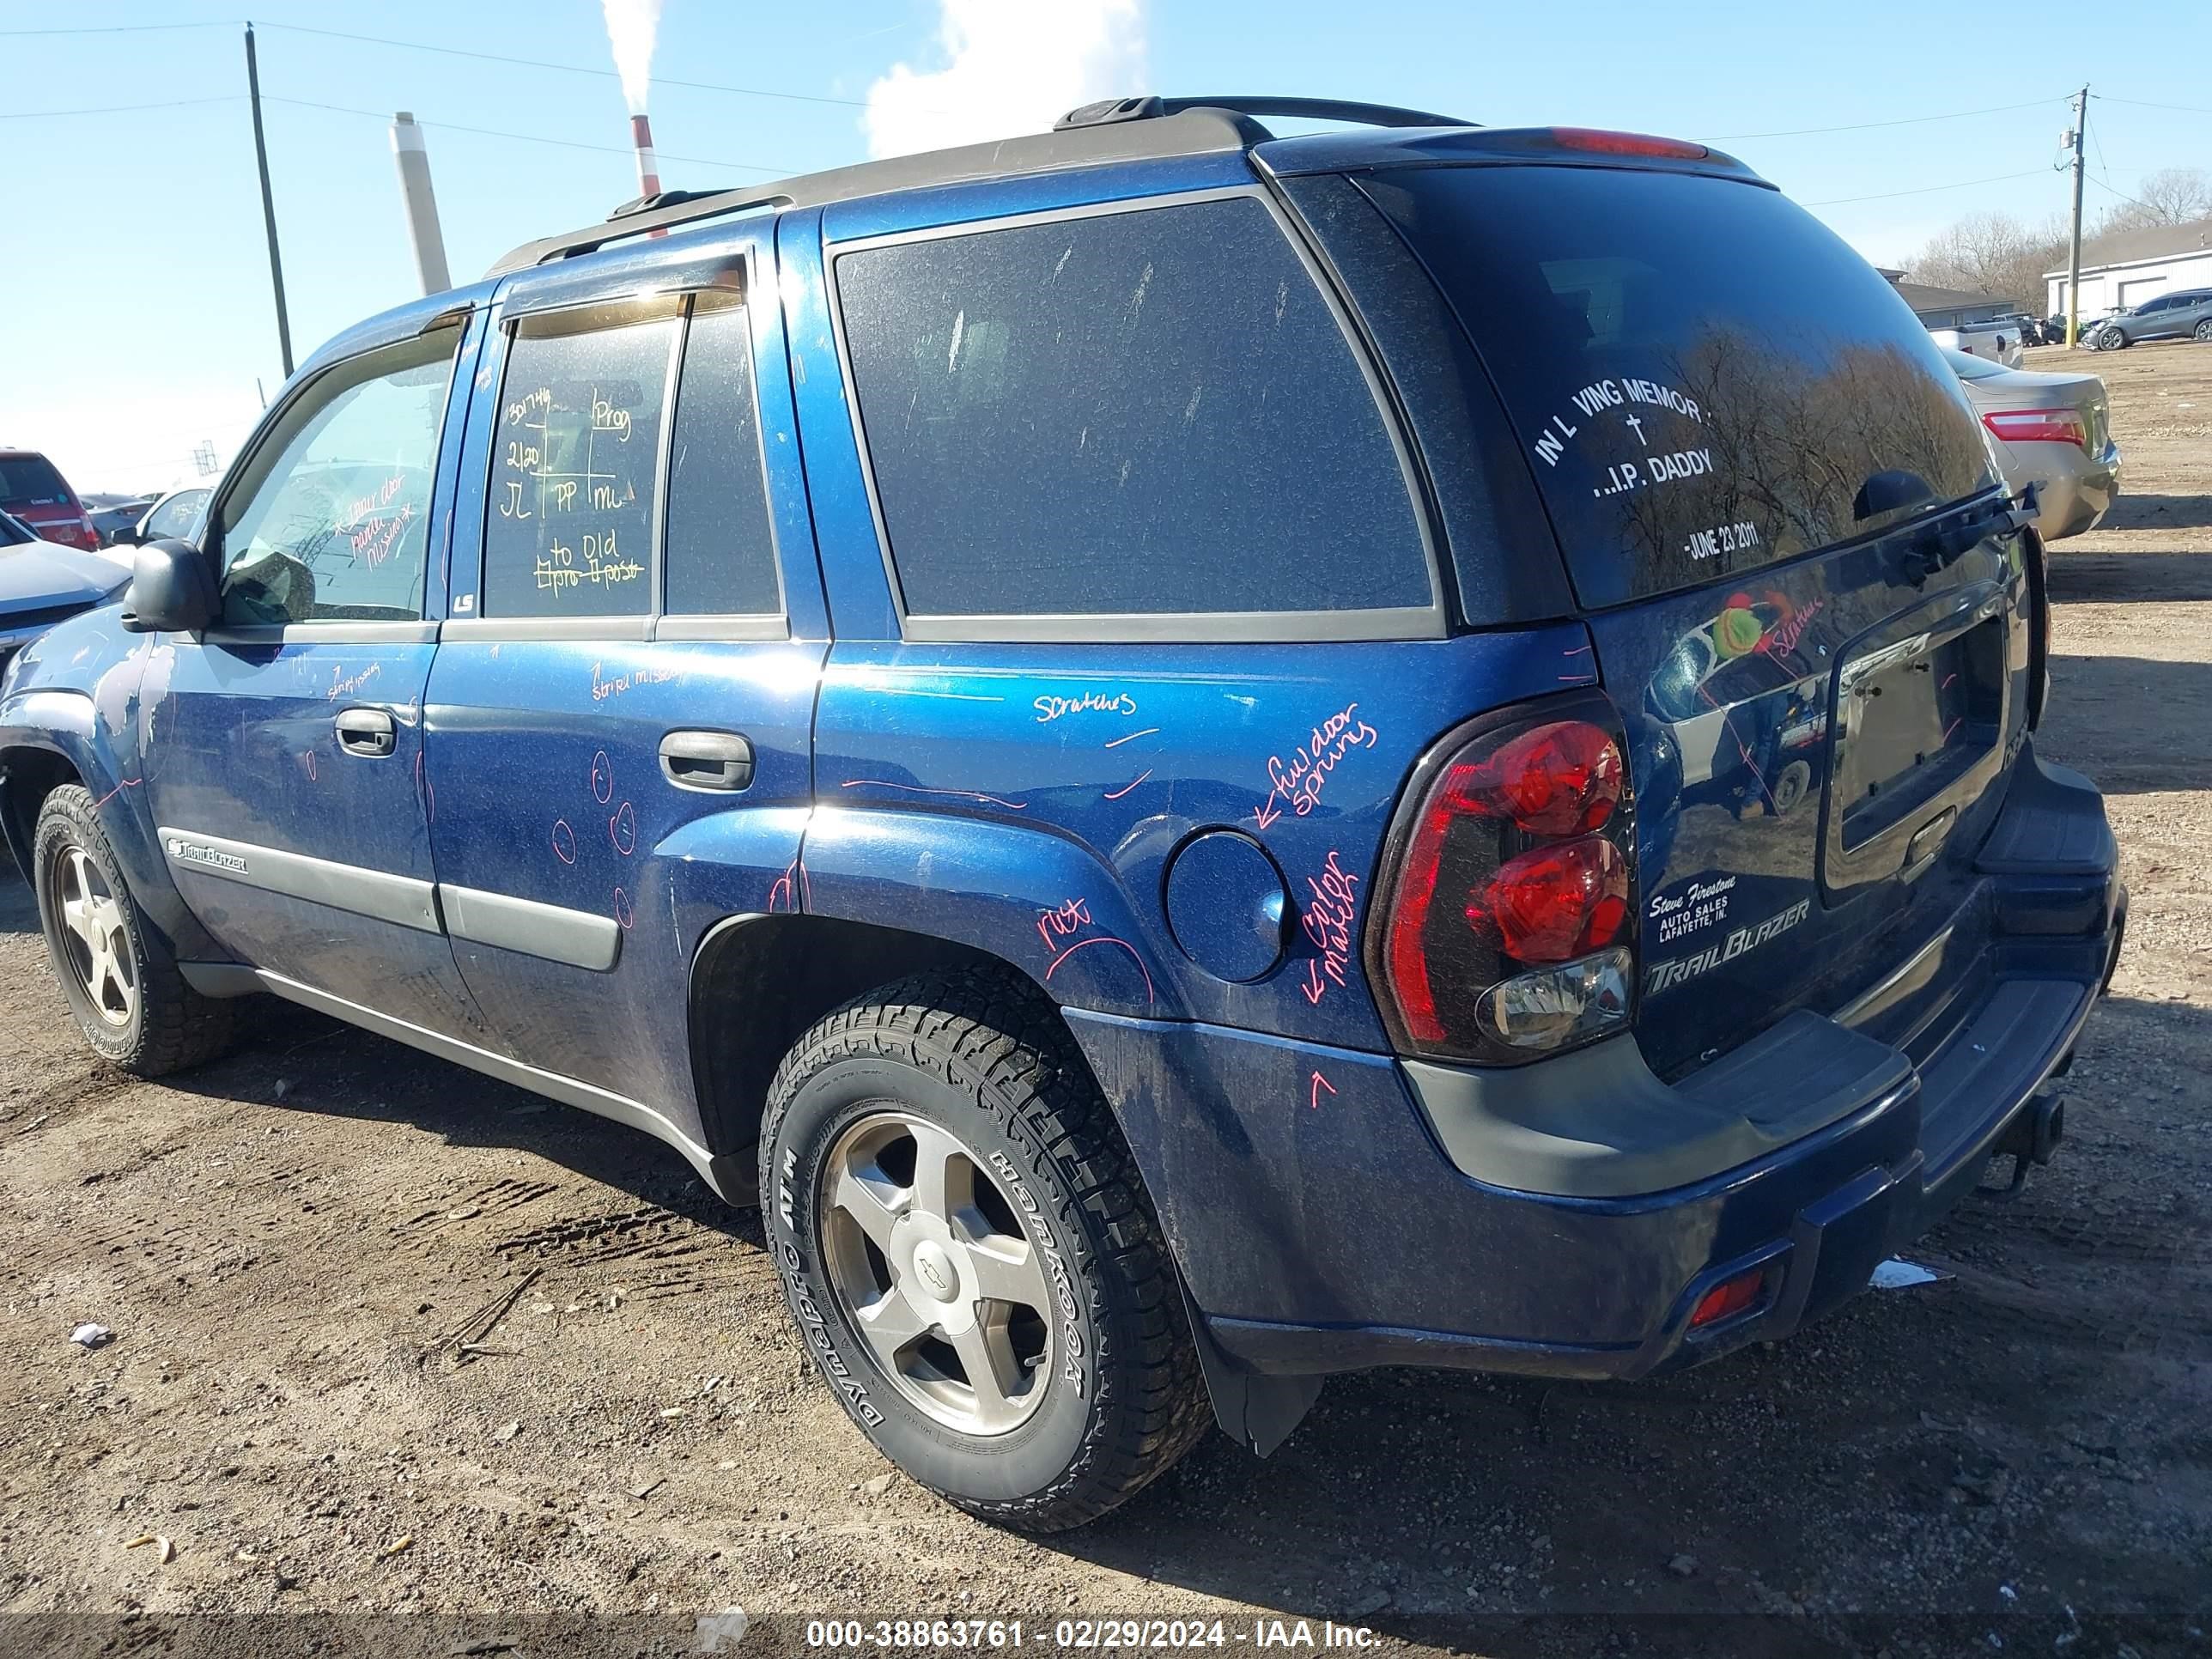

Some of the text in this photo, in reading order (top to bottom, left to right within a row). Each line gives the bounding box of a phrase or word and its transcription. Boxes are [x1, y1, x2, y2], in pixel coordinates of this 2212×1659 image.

[1534, 428, 1565, 468] IN
[1647, 447, 1714, 483] DADDY
[1718, 526, 1735, 552] 23
[1735, 520, 1760, 548] 2011
[453, 593, 474, 613] LS
[1649, 874, 1737, 919] Steve Firestone
[1660, 896, 1729, 932] AUTO SALES
